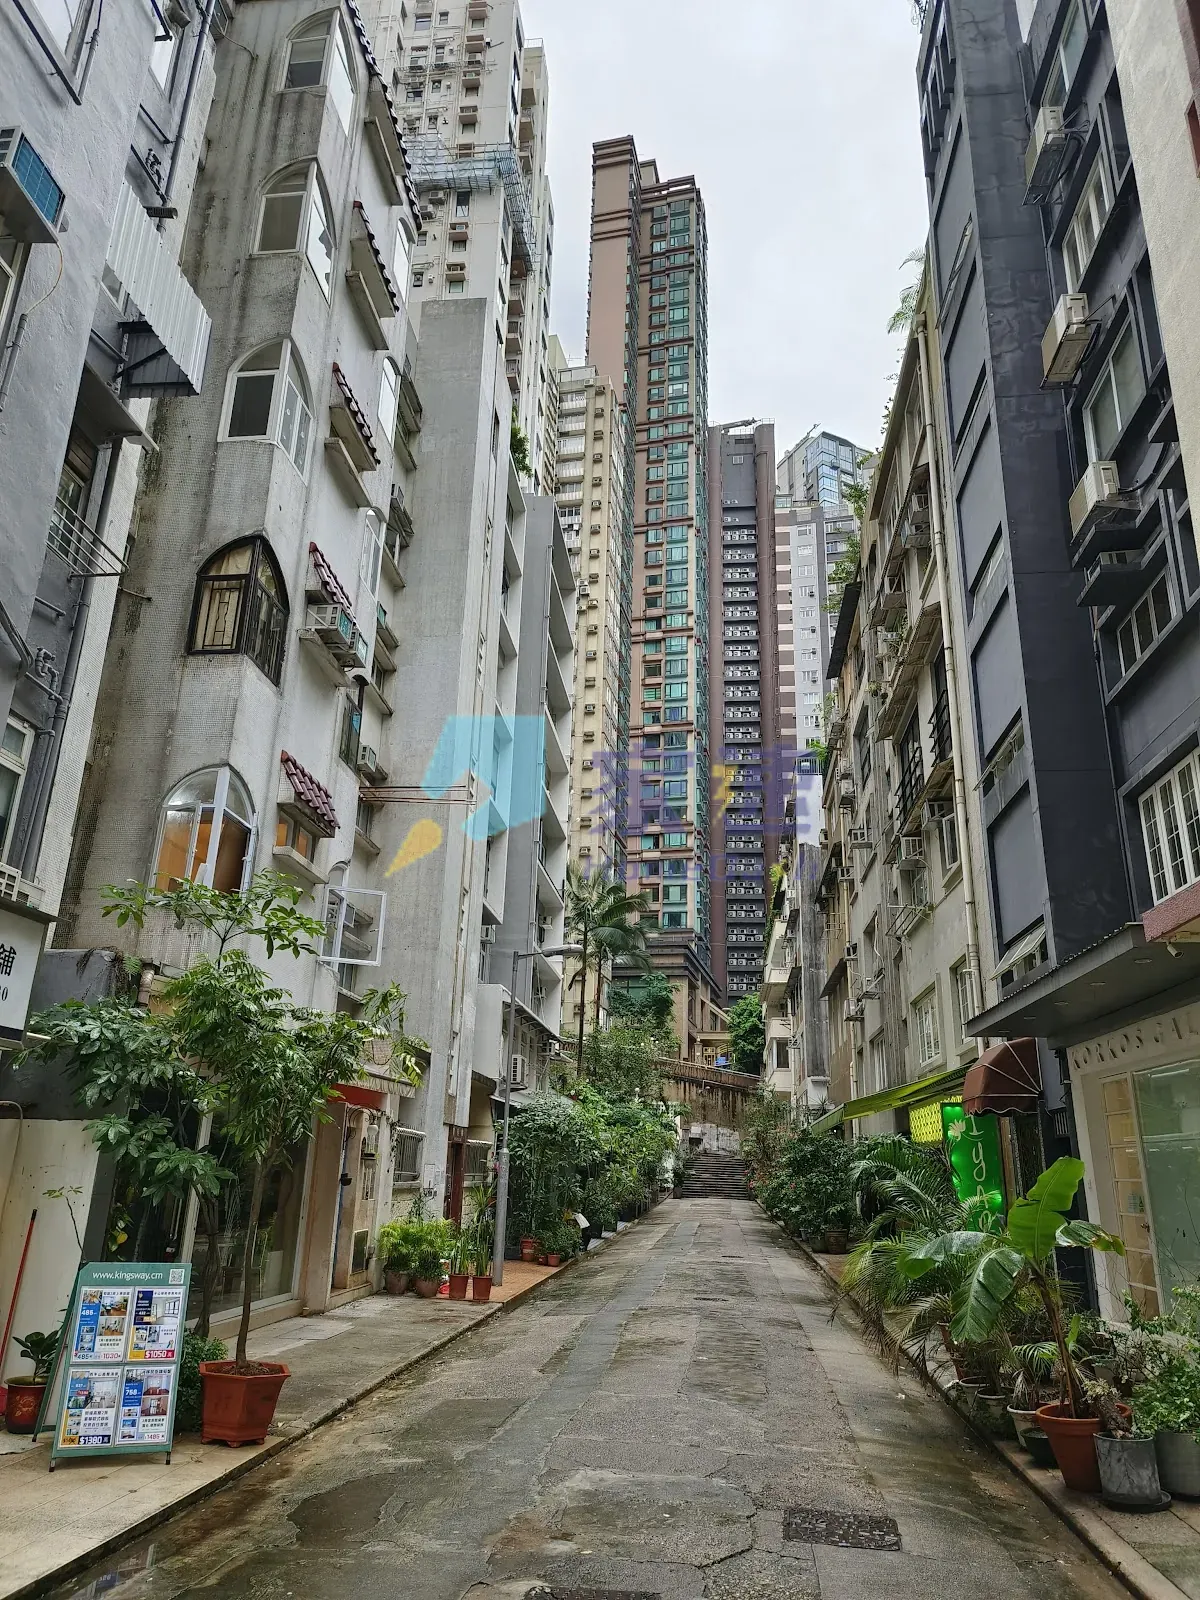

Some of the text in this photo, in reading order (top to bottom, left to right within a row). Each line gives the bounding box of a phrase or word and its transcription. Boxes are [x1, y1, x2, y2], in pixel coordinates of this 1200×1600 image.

[1069, 1028, 1144, 1070] KORKOS
[145, 1350, 167, 1358] $1050
[79, 1436, 103, 1444] $1380
